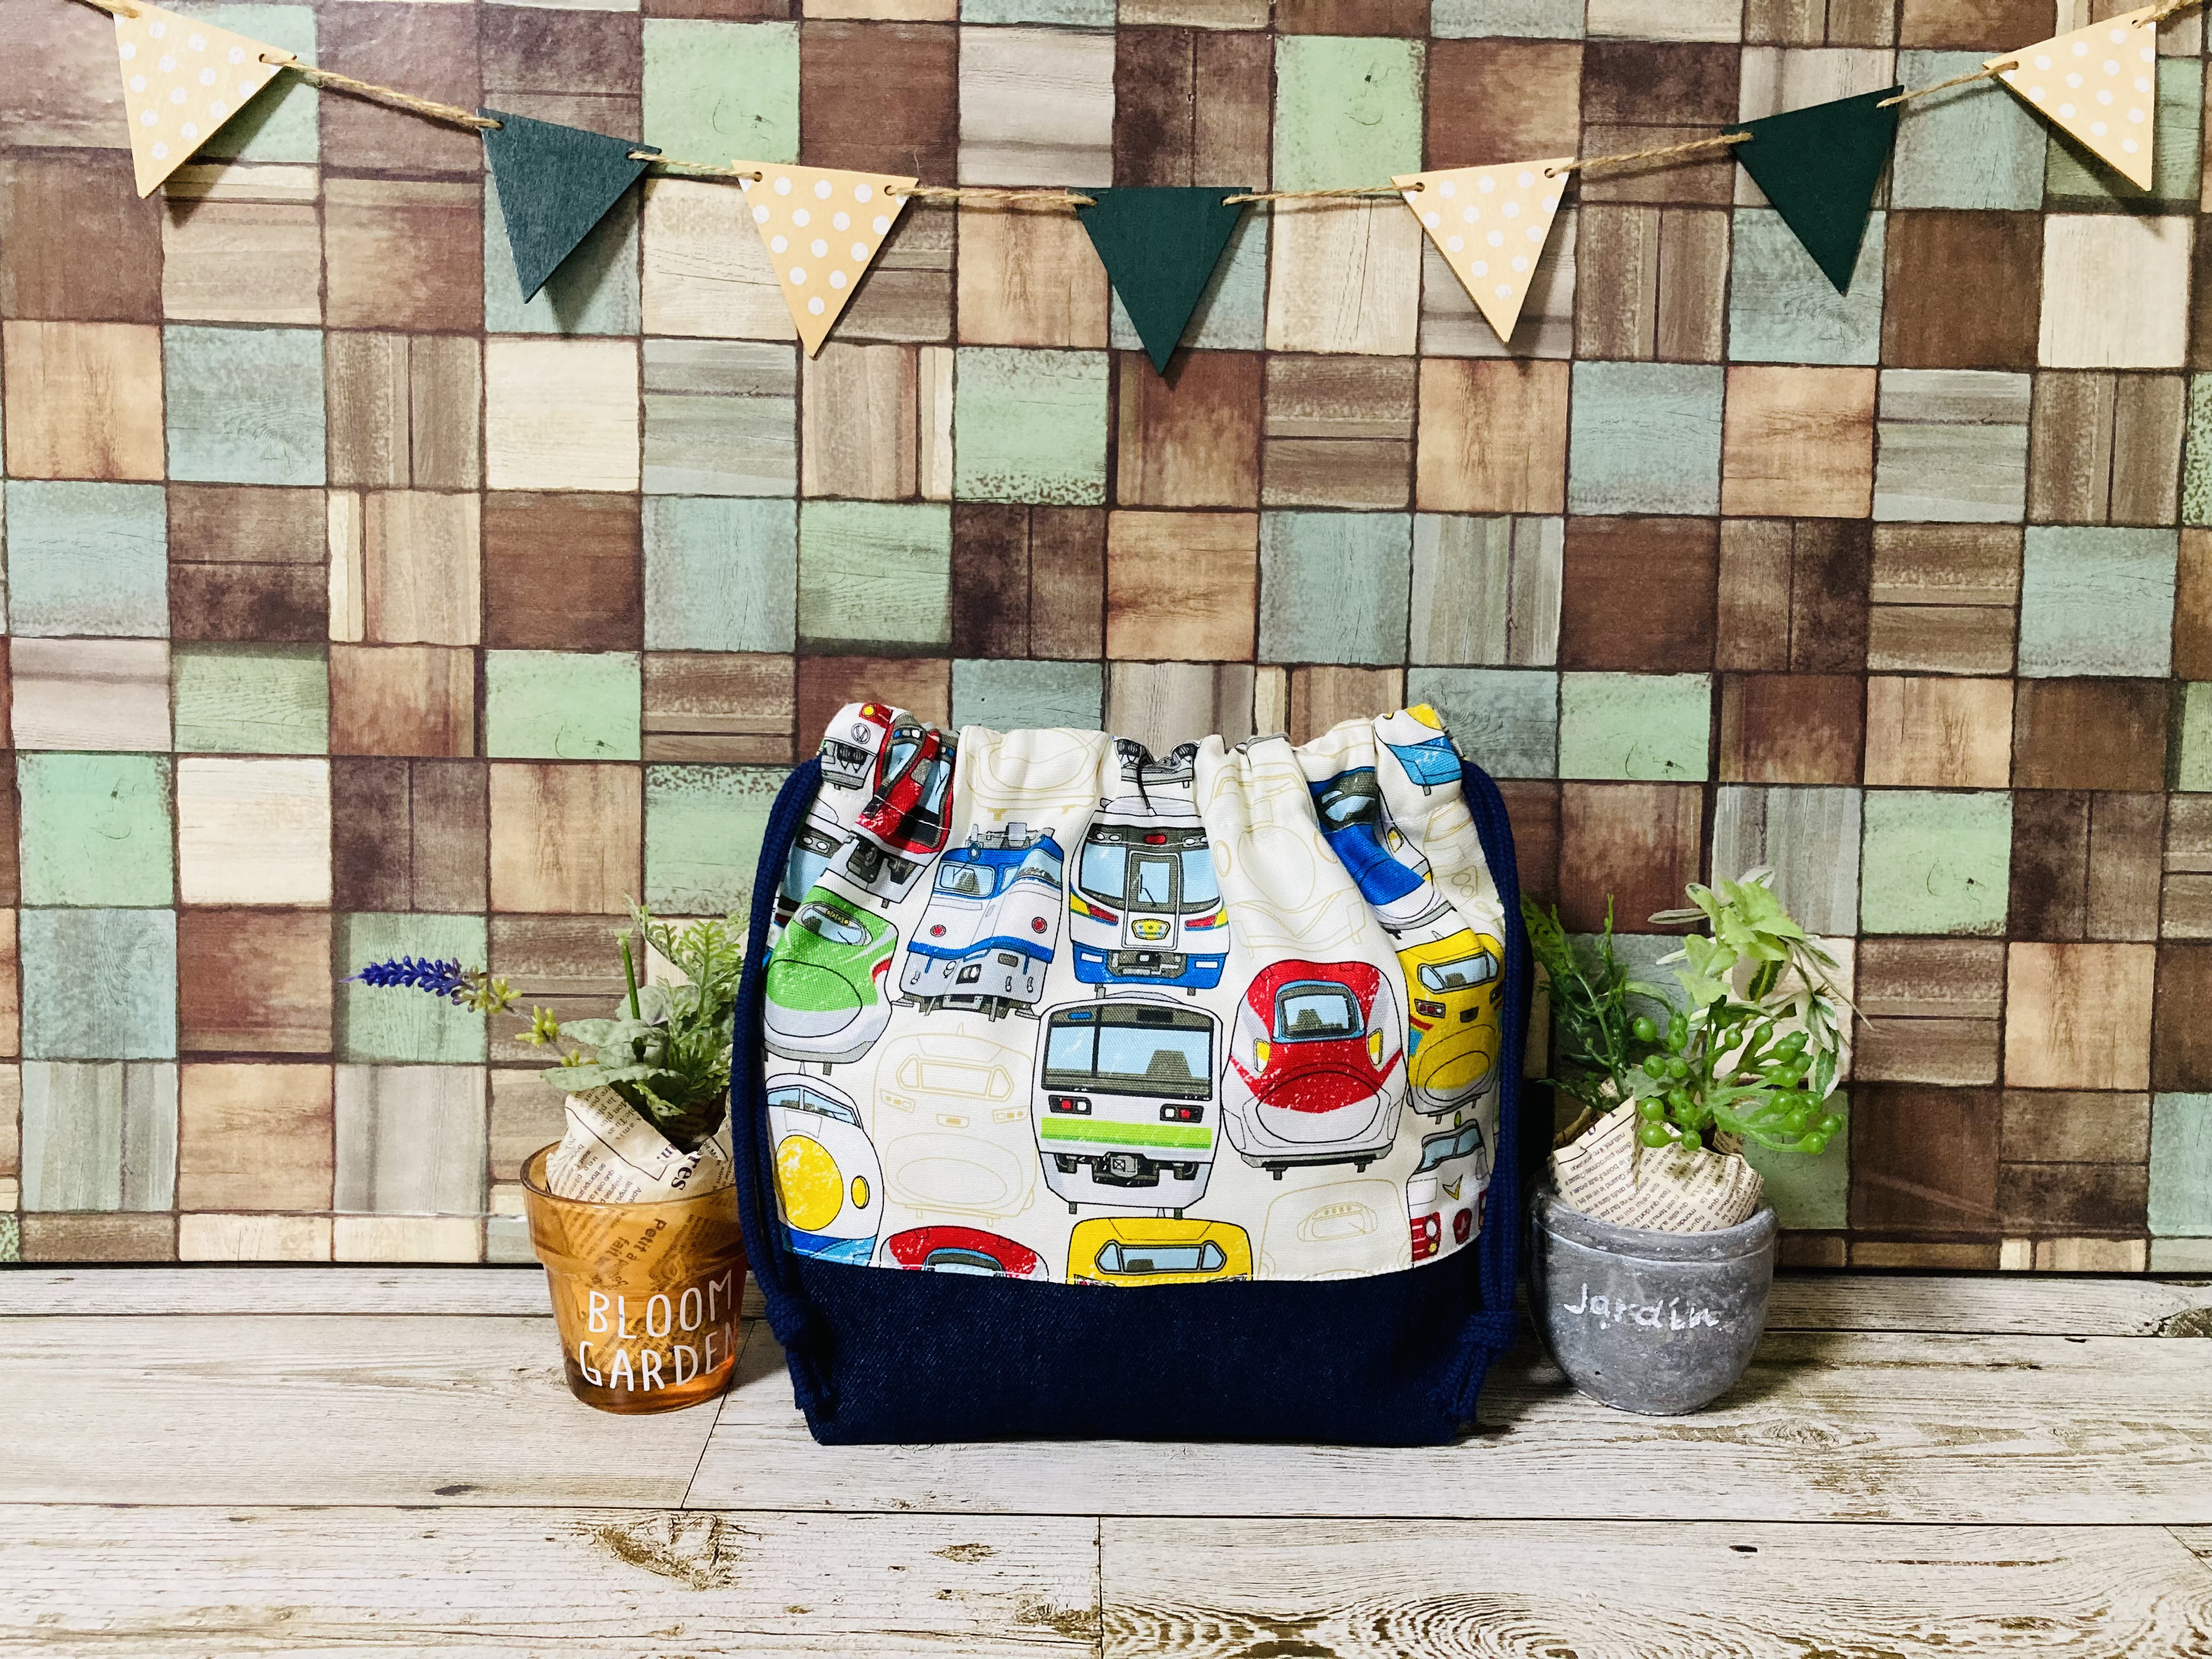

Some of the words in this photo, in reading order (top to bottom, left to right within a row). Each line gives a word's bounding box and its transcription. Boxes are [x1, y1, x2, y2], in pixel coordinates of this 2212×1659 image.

[590, 1103, 608, 1121] plus
[599, 1111, 615, 1129] plus
[614, 1122, 635, 1142] amis
[1615, 1141, 1633, 1155] demi
[597, 1162, 606, 1171] se
[1660, 1161, 1677, 1181] sept
[582, 1170, 601, 1190] trompe
[602, 1168, 614, 1182] que
[1671, 1175, 1680, 1185] du
[1599, 1185, 1606, 1194] le
[1649, 1181, 1660, 1194] que
[1705, 1187, 1714, 1197] de
[1597, 1194, 1612, 1207] dans
[1634, 1192, 1651, 1209] celui
[1649, 1199, 1661, 1211] qui
[1665, 1194, 1680, 1210] n'est
[1699, 1195, 1708, 1205] la
[1706, 1197, 1720, 1211] que
[1615, 1213, 1624, 1222] ne
[1623, 1205, 1636, 1217] qui
[1667, 1200, 1689, 1222] qu'elle
[1675, 1207, 1697, 1228] monde
[1720, 1213, 1728, 1221] le
[633, 1215, 668, 1255] Petit
[604, 1235, 631, 1260] fait
[589, 1269, 731, 1339] BLOOM
[579, 1322, 737, 1391] GARDEN
